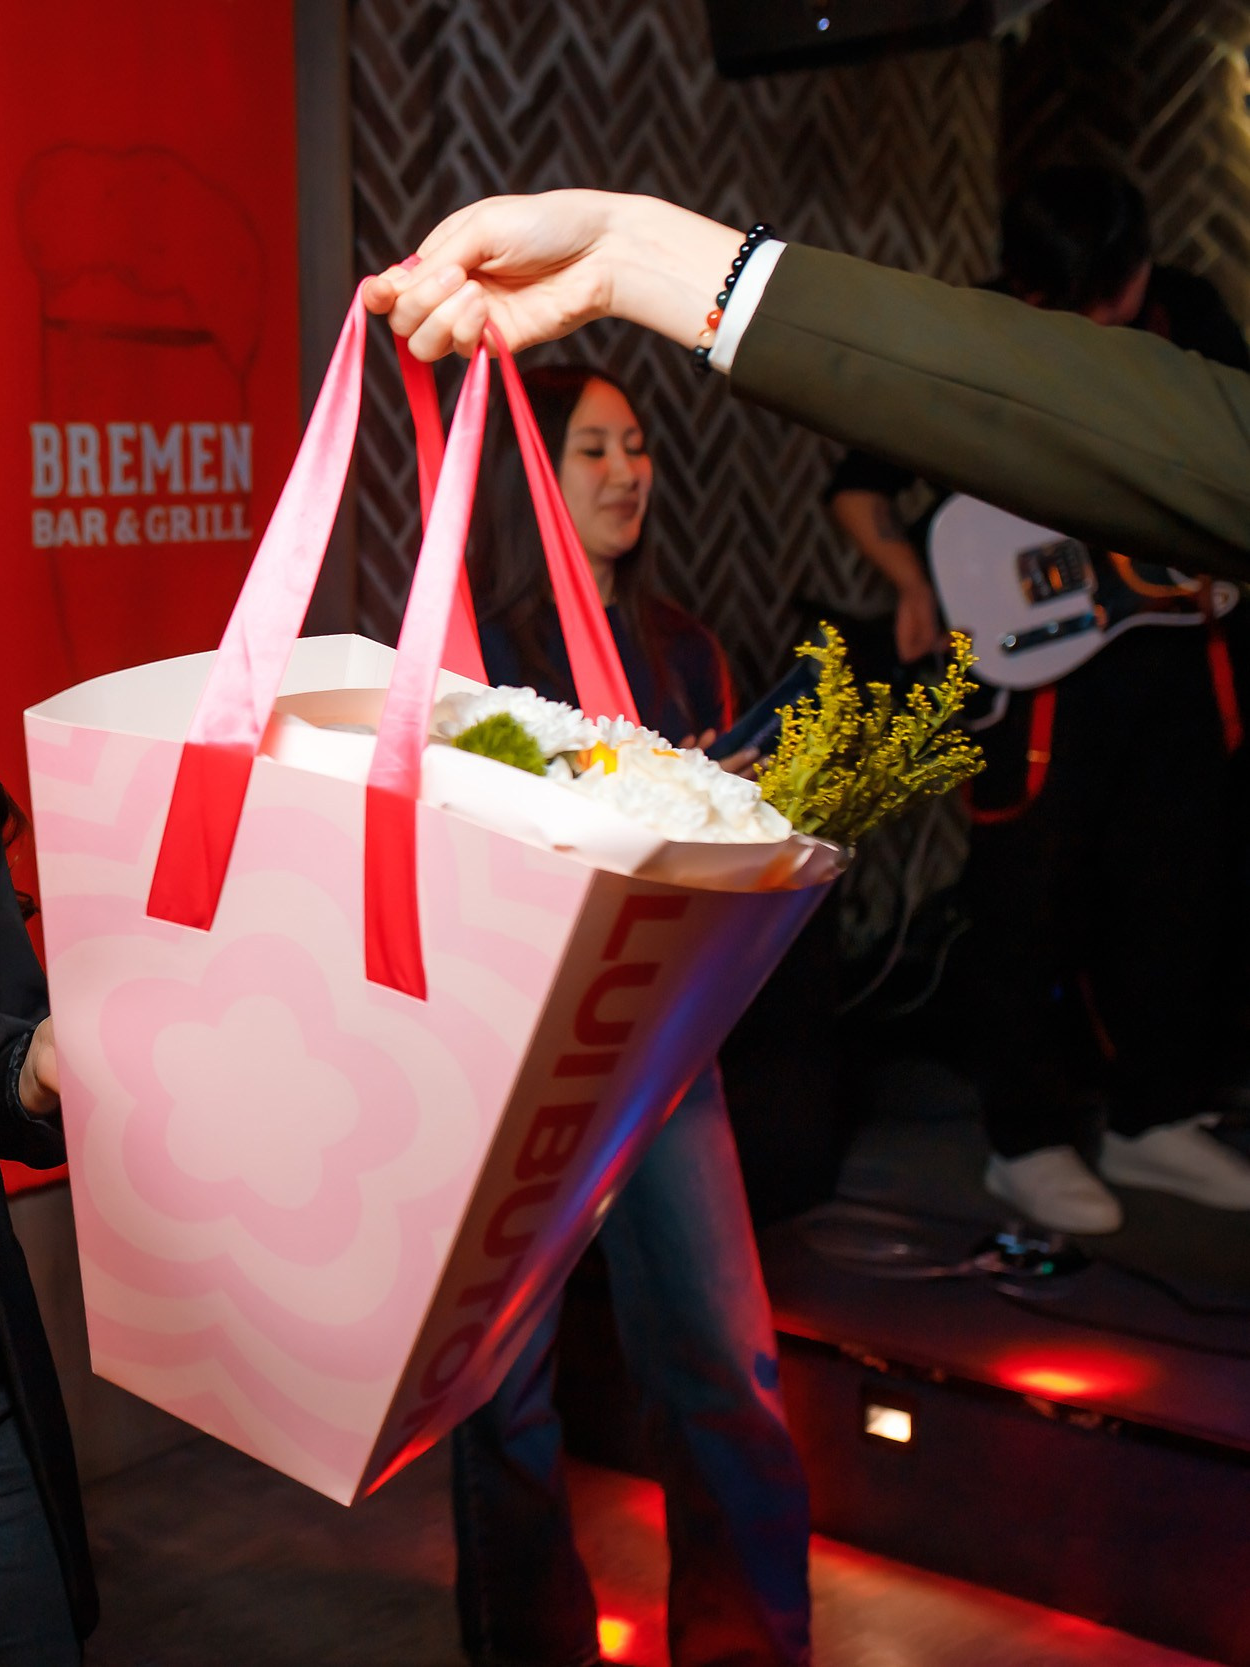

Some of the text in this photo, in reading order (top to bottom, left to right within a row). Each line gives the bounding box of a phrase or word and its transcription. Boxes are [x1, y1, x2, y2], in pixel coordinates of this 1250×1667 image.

[30, 422, 253, 497] BREMEN
[32, 503, 252, 548] BAR & GRILL
